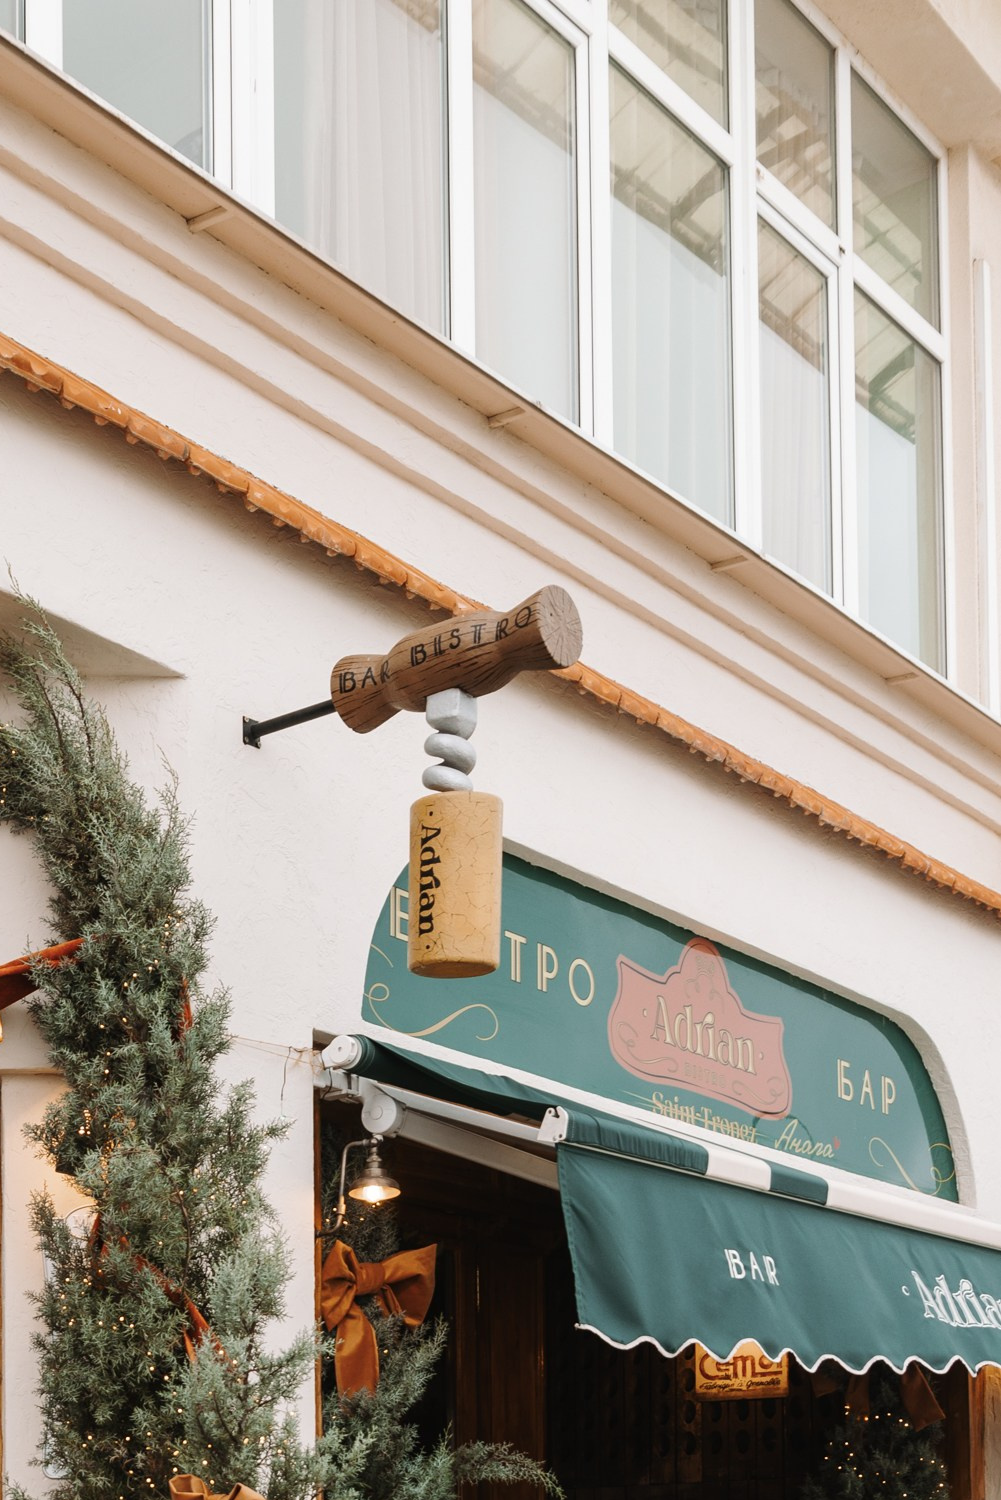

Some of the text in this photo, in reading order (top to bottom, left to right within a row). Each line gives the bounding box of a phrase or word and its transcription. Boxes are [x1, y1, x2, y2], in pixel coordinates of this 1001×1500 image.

[338, 605, 532, 694] BAR BISTRO
[417, 823, 442, 938] Adrian
[389, 886, 595, 1007] БТРО
[650, 995, 757, 1076] Adrian
[837, 1058, 897, 1115] БАР
[724, 1248, 780, 1286] BAR
[911, 1269, 1001, 1330] Adria
